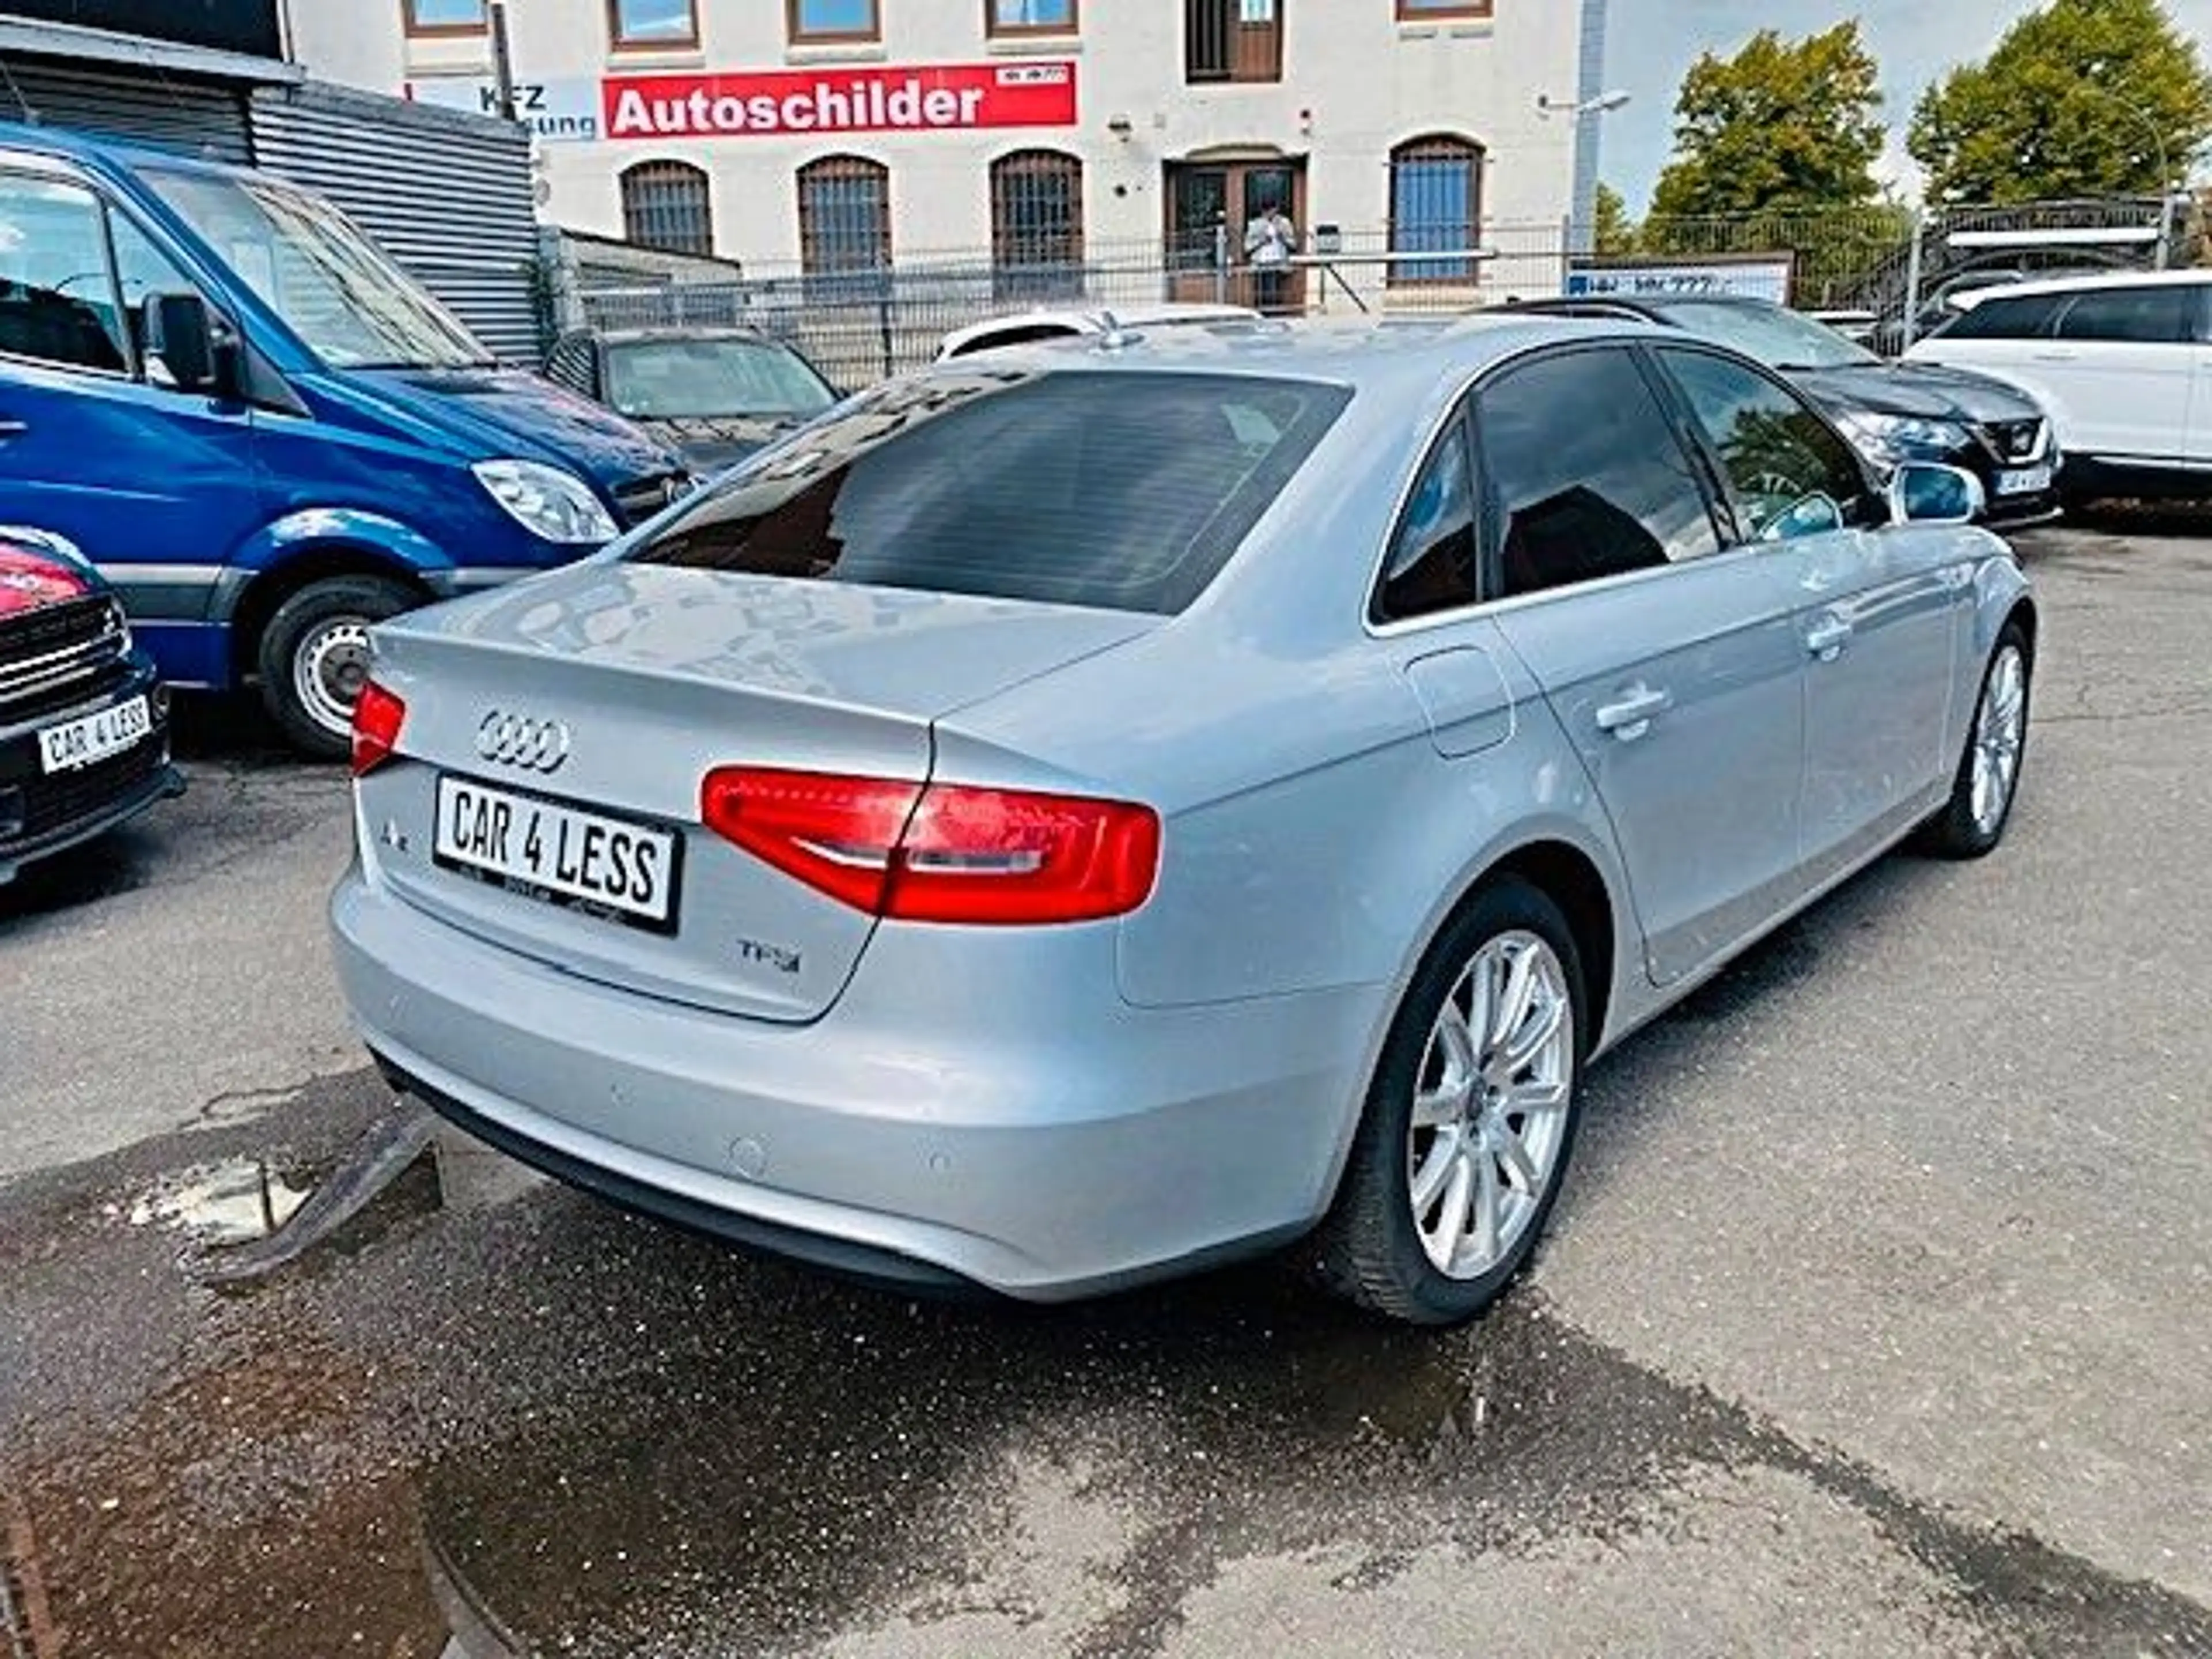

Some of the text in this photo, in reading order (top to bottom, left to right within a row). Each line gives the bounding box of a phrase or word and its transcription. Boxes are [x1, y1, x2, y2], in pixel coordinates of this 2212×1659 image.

[612, 79, 982, 134] Autoschilder
[49, 724, 87, 763] CAR
[109, 701, 145, 741] LESS
[453, 791, 657, 904] CAR 4 LESS
